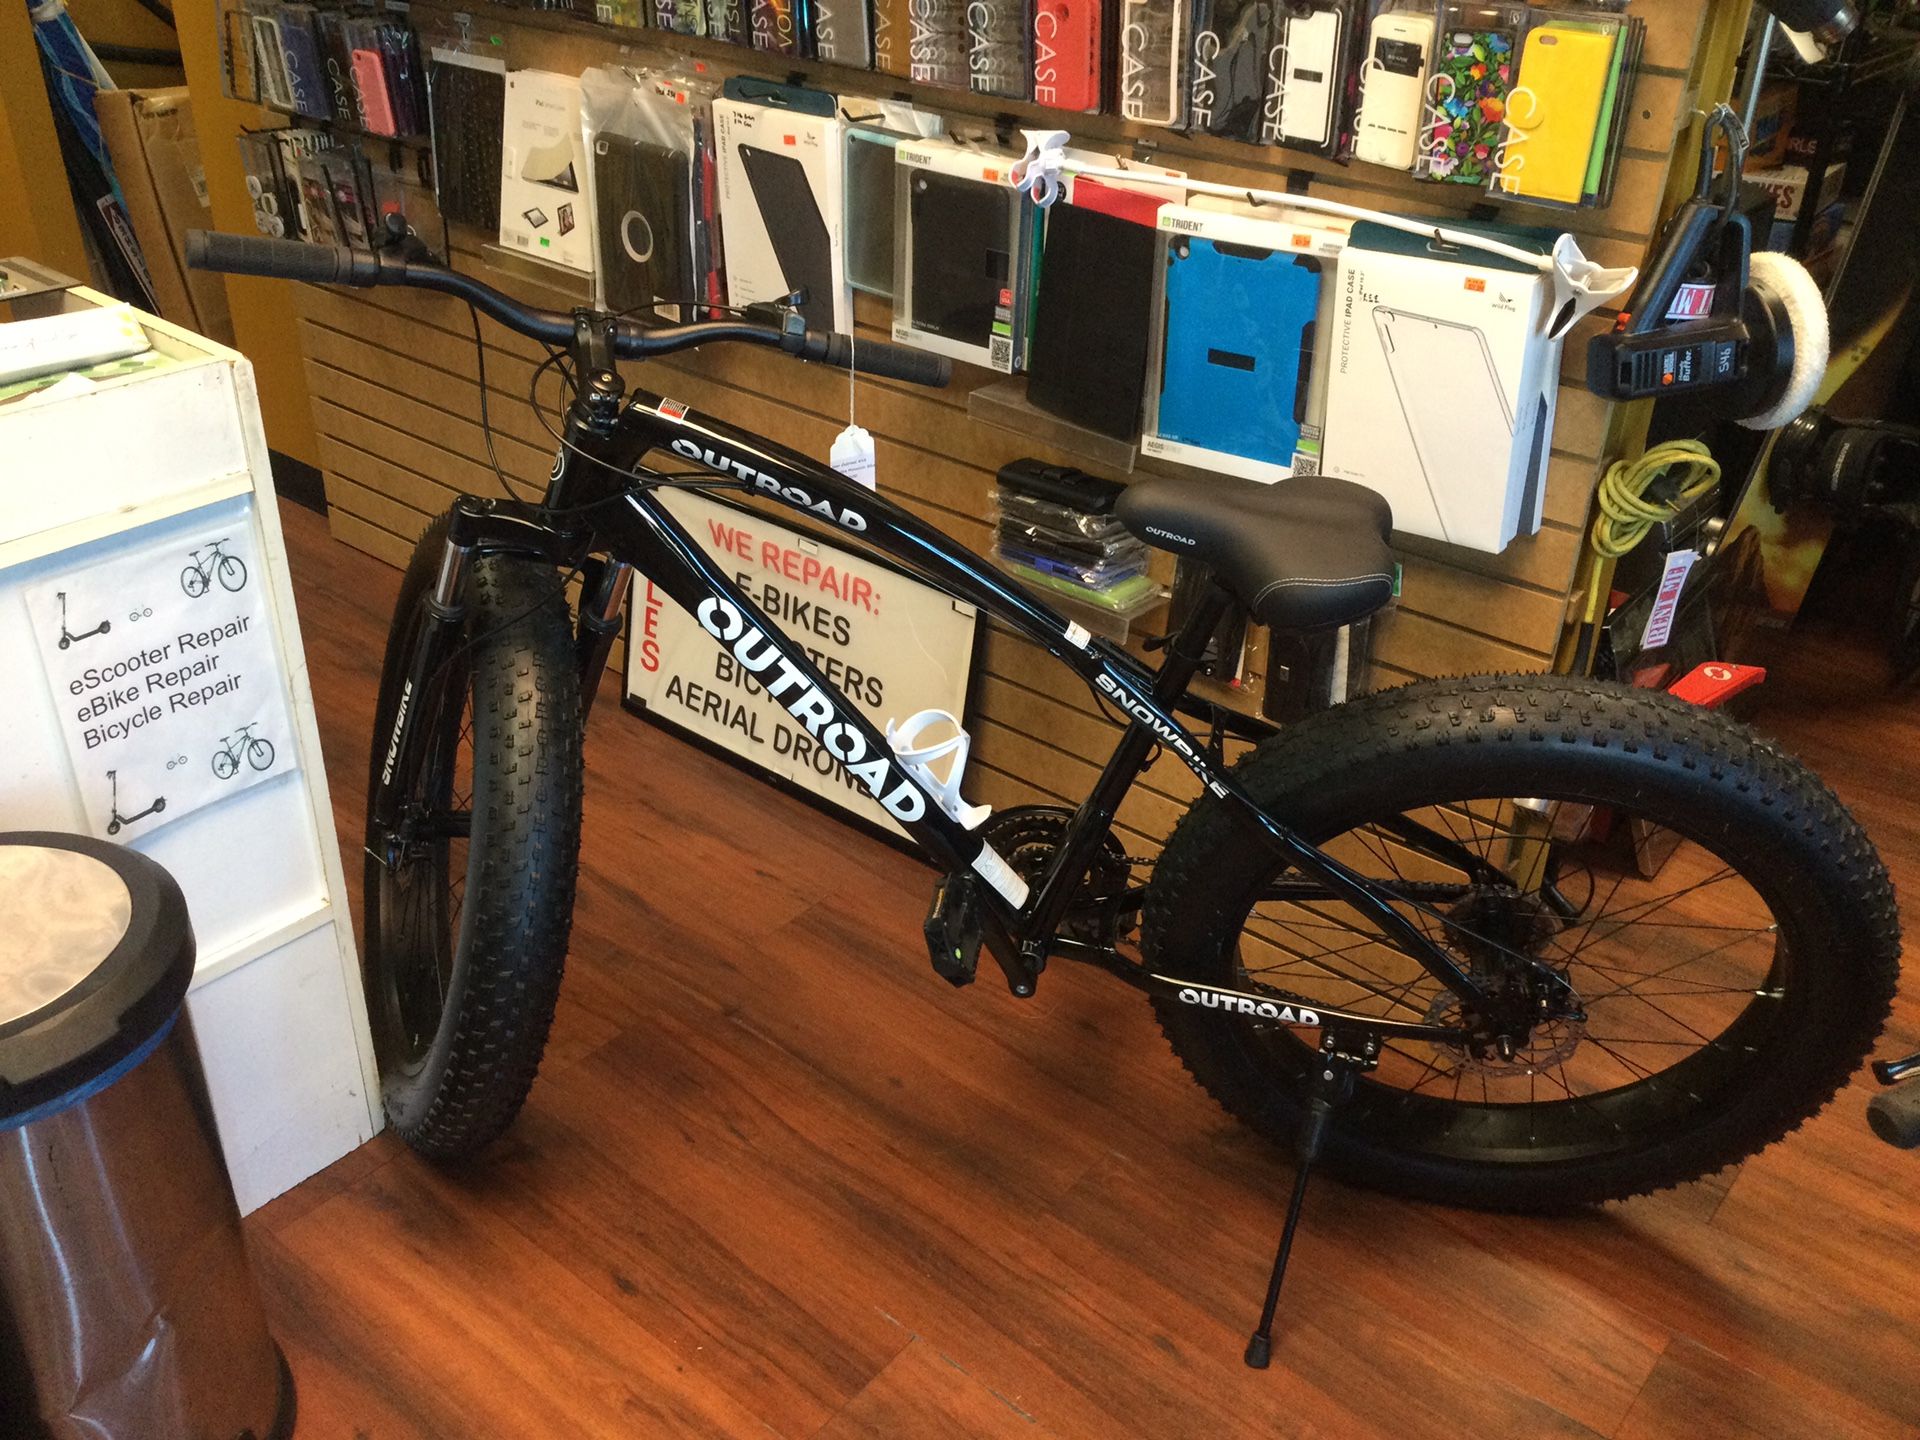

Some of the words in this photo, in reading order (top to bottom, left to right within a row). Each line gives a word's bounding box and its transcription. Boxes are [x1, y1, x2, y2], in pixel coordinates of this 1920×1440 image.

[751, 0, 769, 49] ASE
[814, 1, 836, 60] ASE
[967, 1, 990, 92] CASE
[1034, 10, 1057, 104] CASE
[285, 50, 309, 114] CASE
[327, 57, 350, 121] CASE
[350, 66, 371, 131] CASE
[1121, 23, 1146, 119] CASE
[1191, 30, 1221, 128] CASE
[1262, 43, 1291, 143] CASE
[906, 151, 932, 165] TRIDENT
[1416, 72, 1457, 173] CASE
[1488, 86, 1538, 196] CASE
[1171, 217, 1204, 232] TRIDENT
[1344, 295, 1354, 318] IPAD
[1346, 268, 1356, 294] CASE
[1339, 318, 1353, 375] PROTECTIVE
[671, 438, 868, 532] OUTROAD
[707, 518, 754, 563] WE
[761, 540, 883, 617] REPAIR:
[1145, 525, 1197, 546] OUTROAD
[1647, 599, 1674, 645] RENT
[1661, 566, 1687, 593] ME
[69, 644, 171, 696] eScooter
[177, 615, 250, 655] Repair
[77, 686, 140, 722] eBike
[145, 654, 220, 694] Repair
[83, 705, 162, 750] Bicycle
[169, 674, 242, 714] Repair
[664, 674, 766, 745] AERIAL
[697, 596, 927, 823] OUTROAD
[1179, 987, 1321, 1027] OUTROAD
